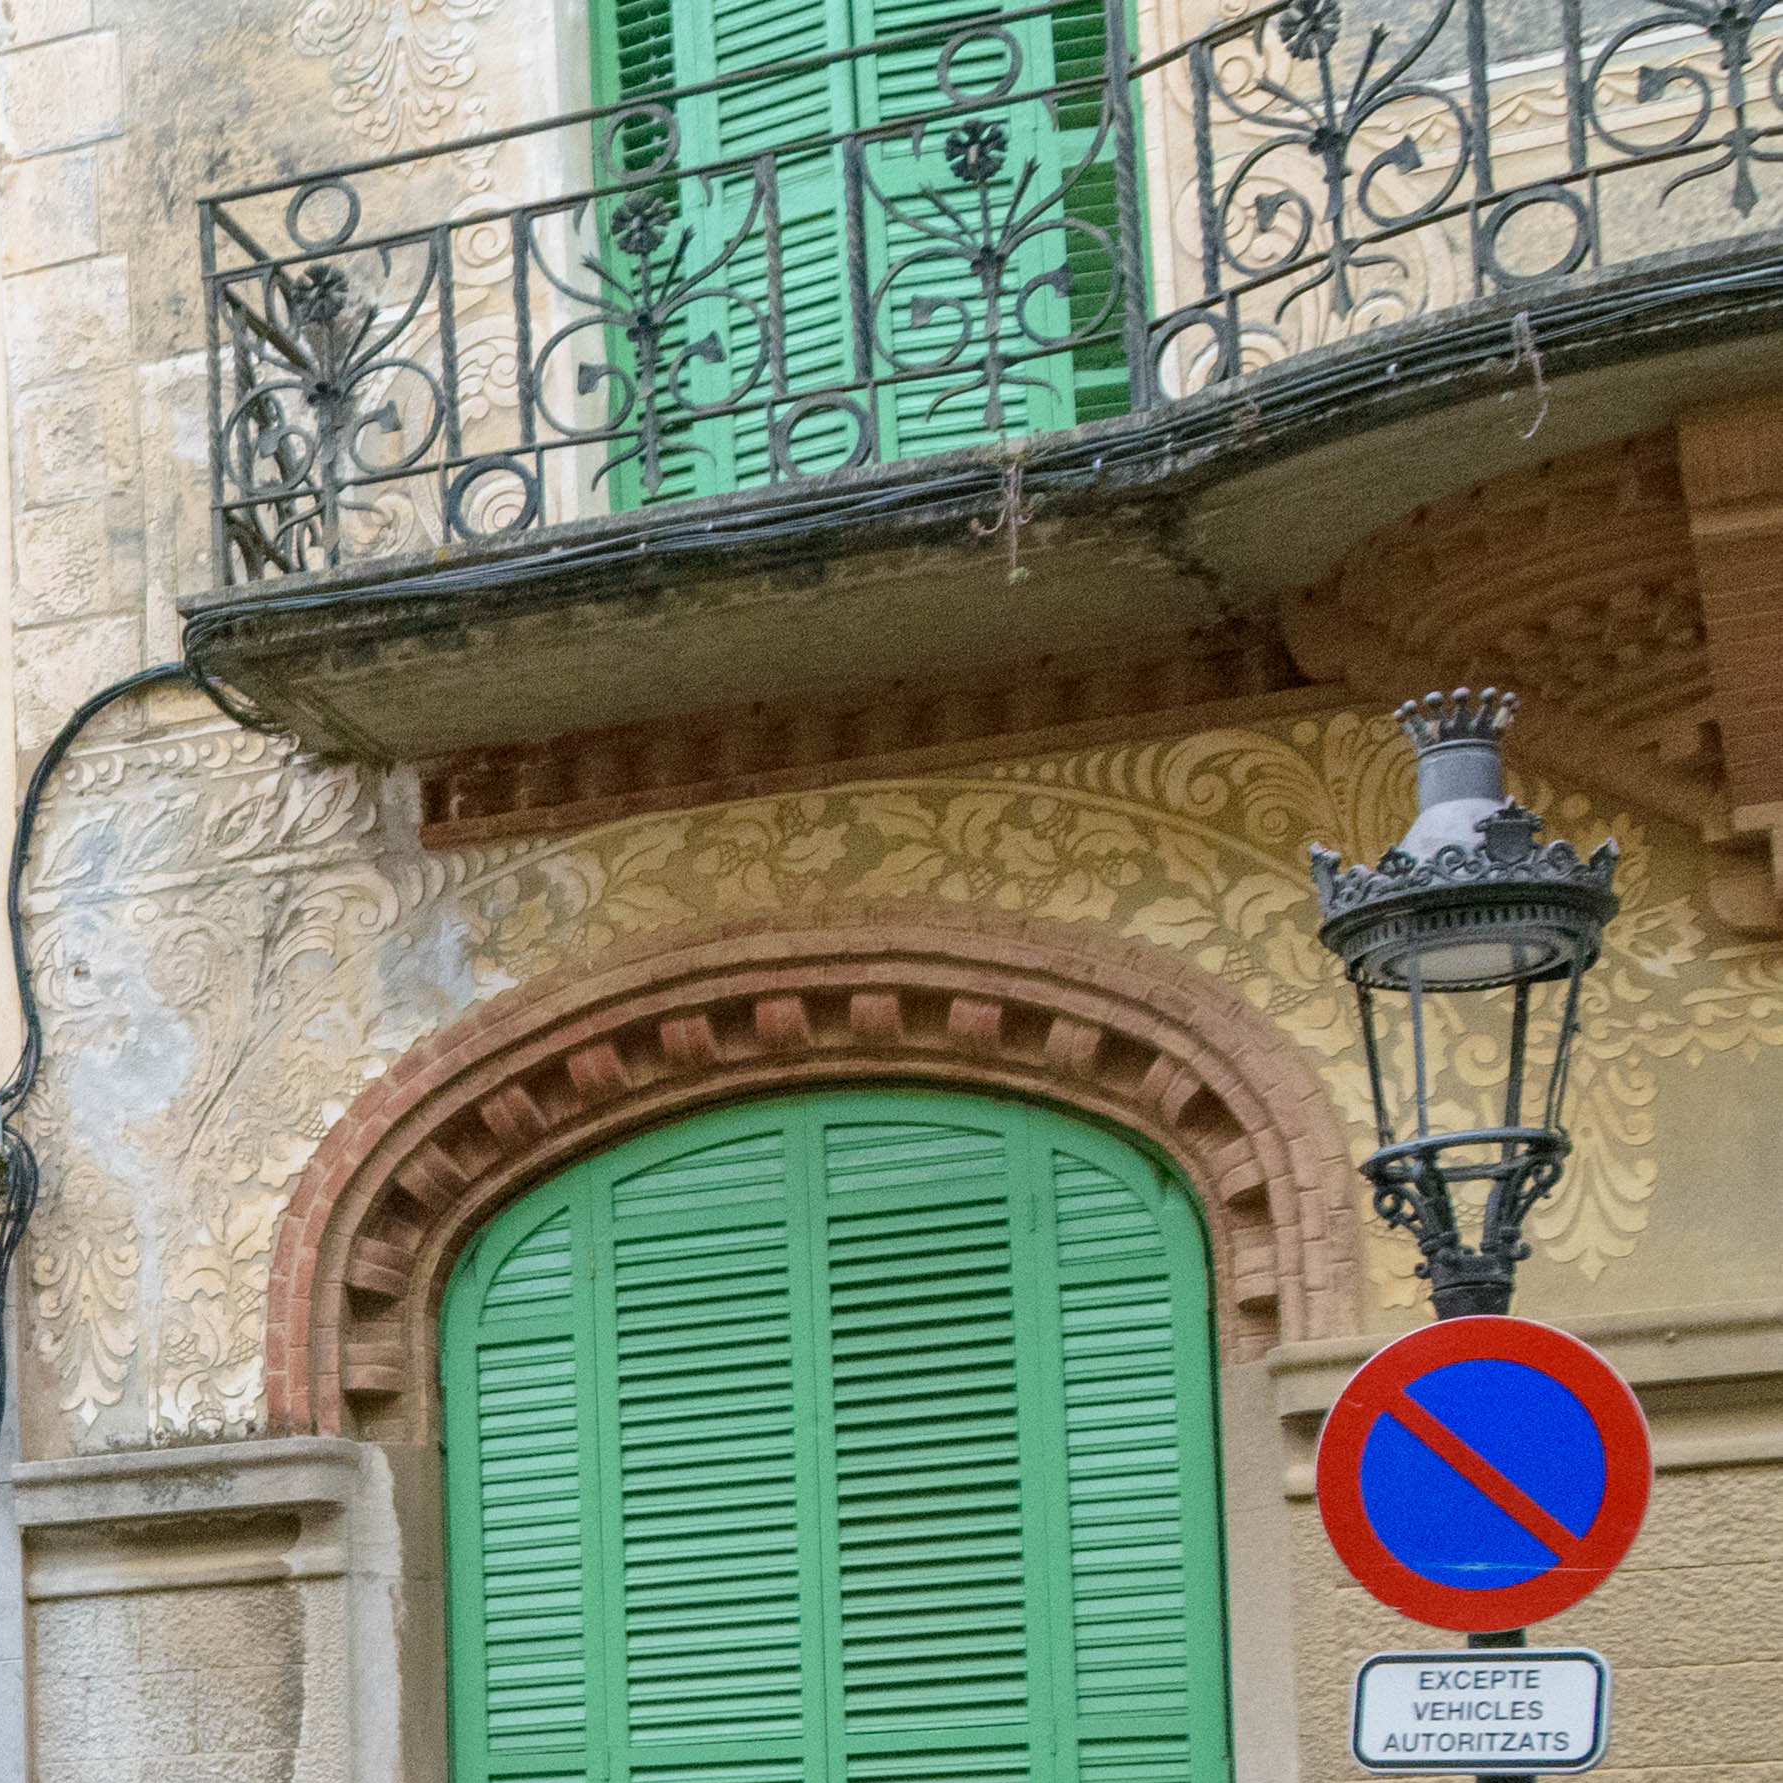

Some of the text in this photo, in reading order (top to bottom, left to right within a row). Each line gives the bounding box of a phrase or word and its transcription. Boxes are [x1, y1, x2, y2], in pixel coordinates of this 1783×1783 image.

[1419, 1669, 1541, 1690] EXCEPTE
[1413, 1701, 1544, 1721] VEHICLES
[1383, 1732, 1570, 1752] AUTORITZATS
